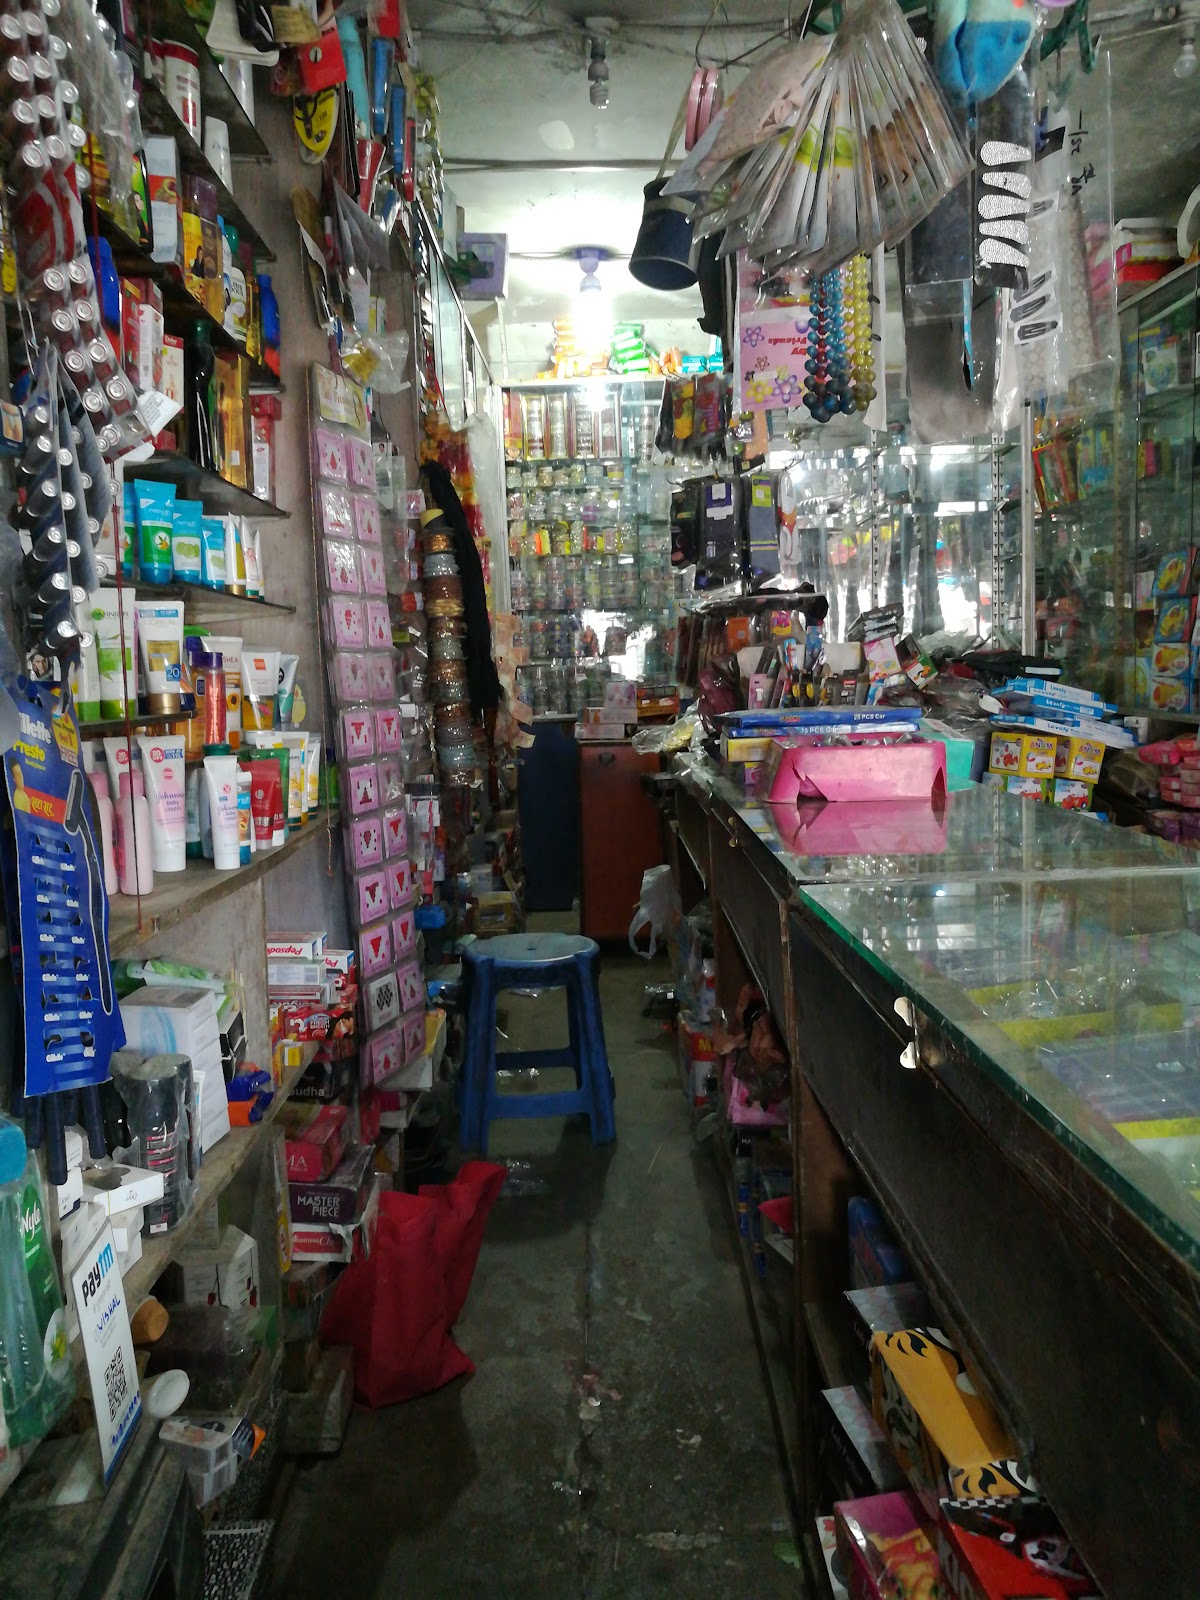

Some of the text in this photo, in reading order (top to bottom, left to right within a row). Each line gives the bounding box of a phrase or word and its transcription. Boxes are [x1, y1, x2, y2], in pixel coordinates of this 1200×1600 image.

[222, 656, 239, 664] SHEA
[166, 667, 180, 678] 20
[1047, 722, 1069, 733] Lovely
[166, 800, 180, 809] baby
[297, 1195, 340, 1207] MASTER
[312, 1206, 340, 1217] PIECE
[20, 1201, 41, 1241] Nyle
